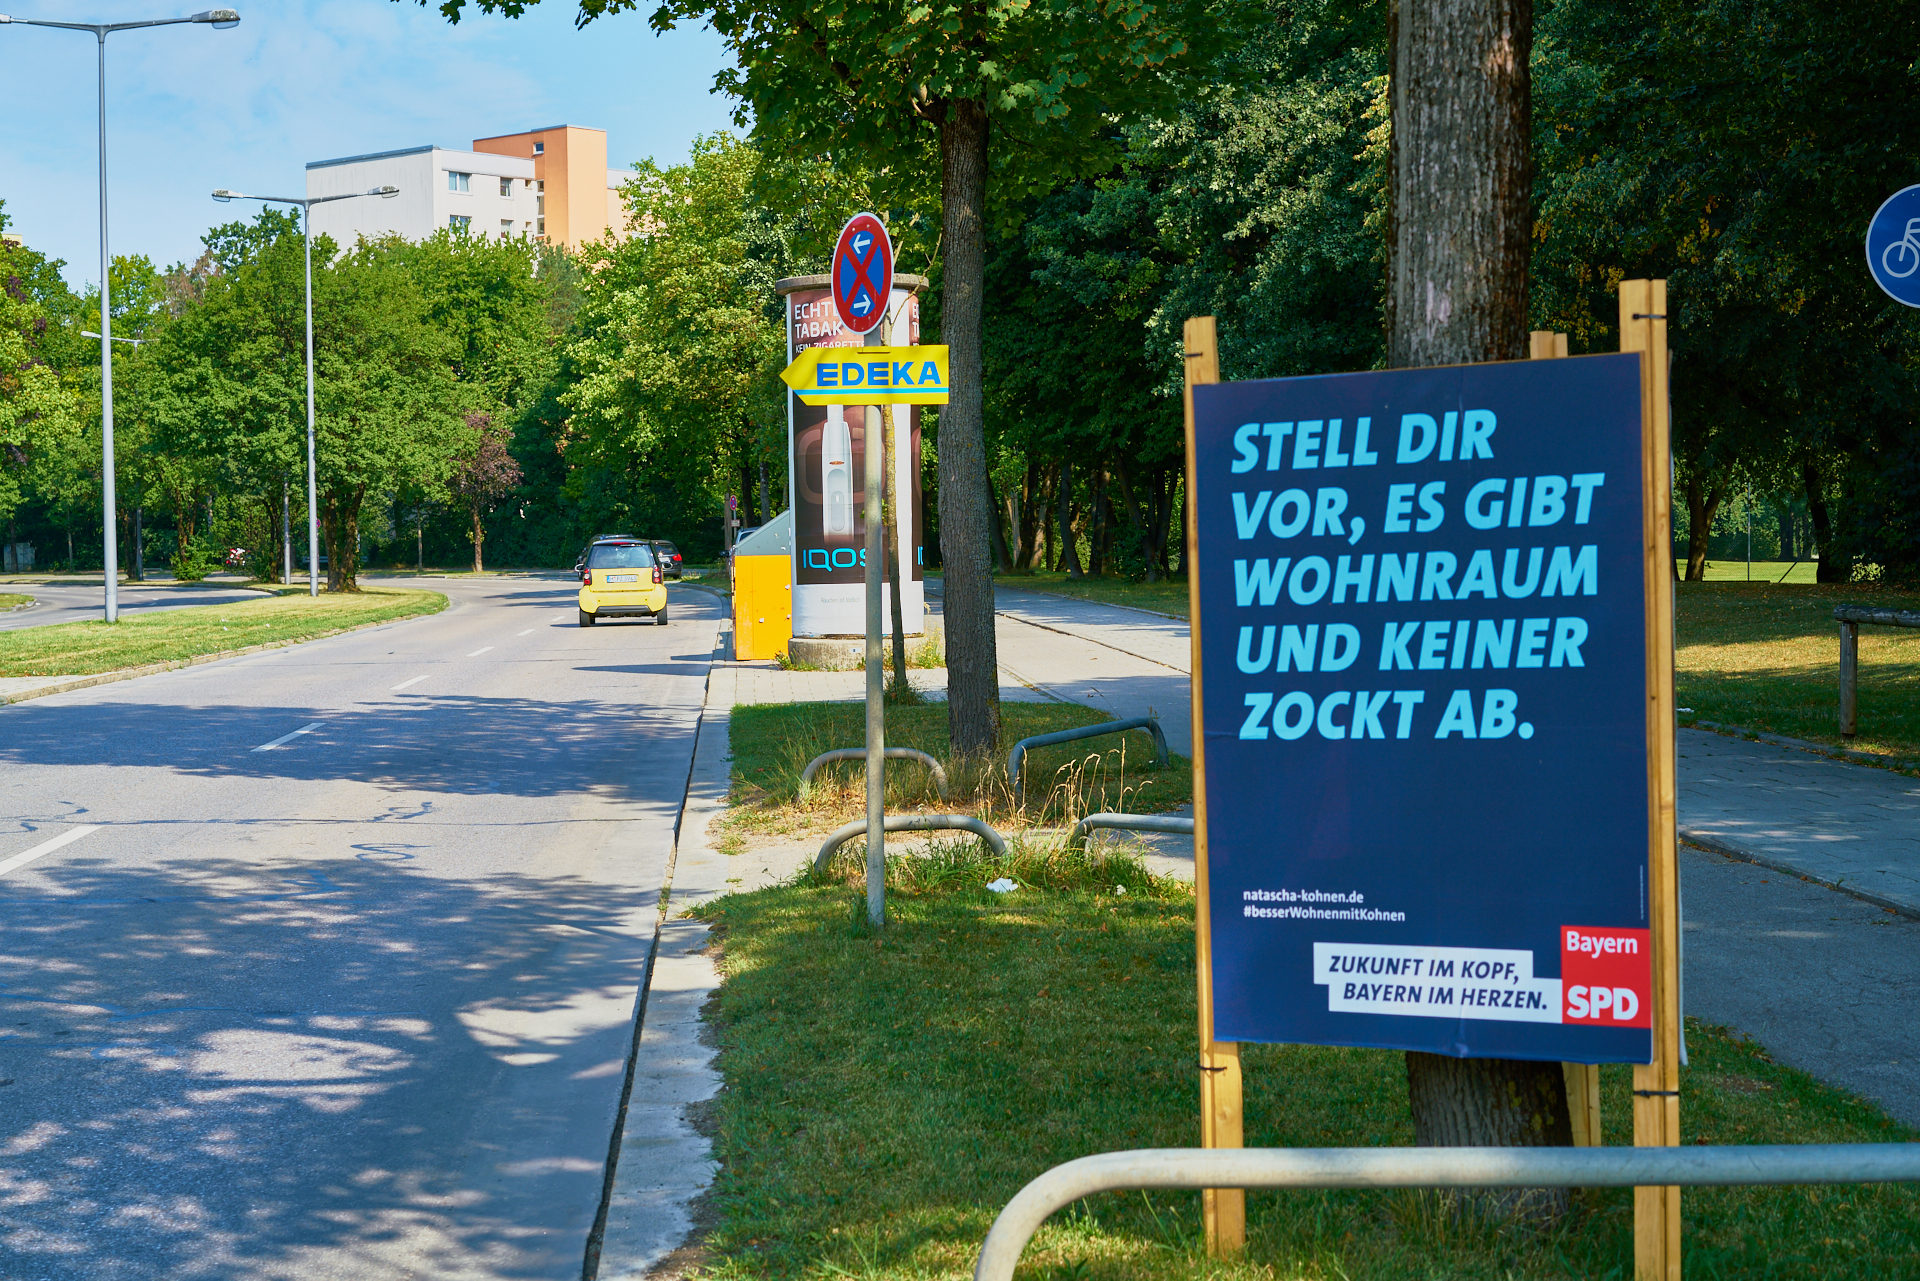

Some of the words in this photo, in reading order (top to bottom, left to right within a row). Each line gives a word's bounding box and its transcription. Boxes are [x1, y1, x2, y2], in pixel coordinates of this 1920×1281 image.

[794, 320, 843, 339] TABAK
[817, 361, 941, 387] EDEKA
[1231, 416, 1379, 474] STELL
[1396, 408, 1497, 464] DIR
[1231, 486, 1366, 546] VOR,
[1383, 480, 1447, 534] ES
[1464, 472, 1606, 530] GIBT
[1233, 544, 1598, 607] WOHNRAUM
[1236, 622, 1361, 675] UND
[1378, 616, 1589, 671] KEINER
[1238, 690, 1426, 741] ZOCKT
[1434, 688, 1535, 740] AB.
[1243, 888, 1364, 904] natascha-kohnen.de
[1243, 904, 1406, 922] #besserWohnenmitKohnen
[1566, 930, 1638, 959] Bayern
[1328, 955, 1424, 976] ZUKUNFT
[1428, 959, 1454, 978] IM
[1461, 960, 1519, 985] KOPF,
[1343, 982, 1422, 1003] BAYERN
[1428, 986, 1454, 1005] IM
[1460, 988, 1548, 1010] HERZEN.
[1566, 984, 1639, 1021] SPD
